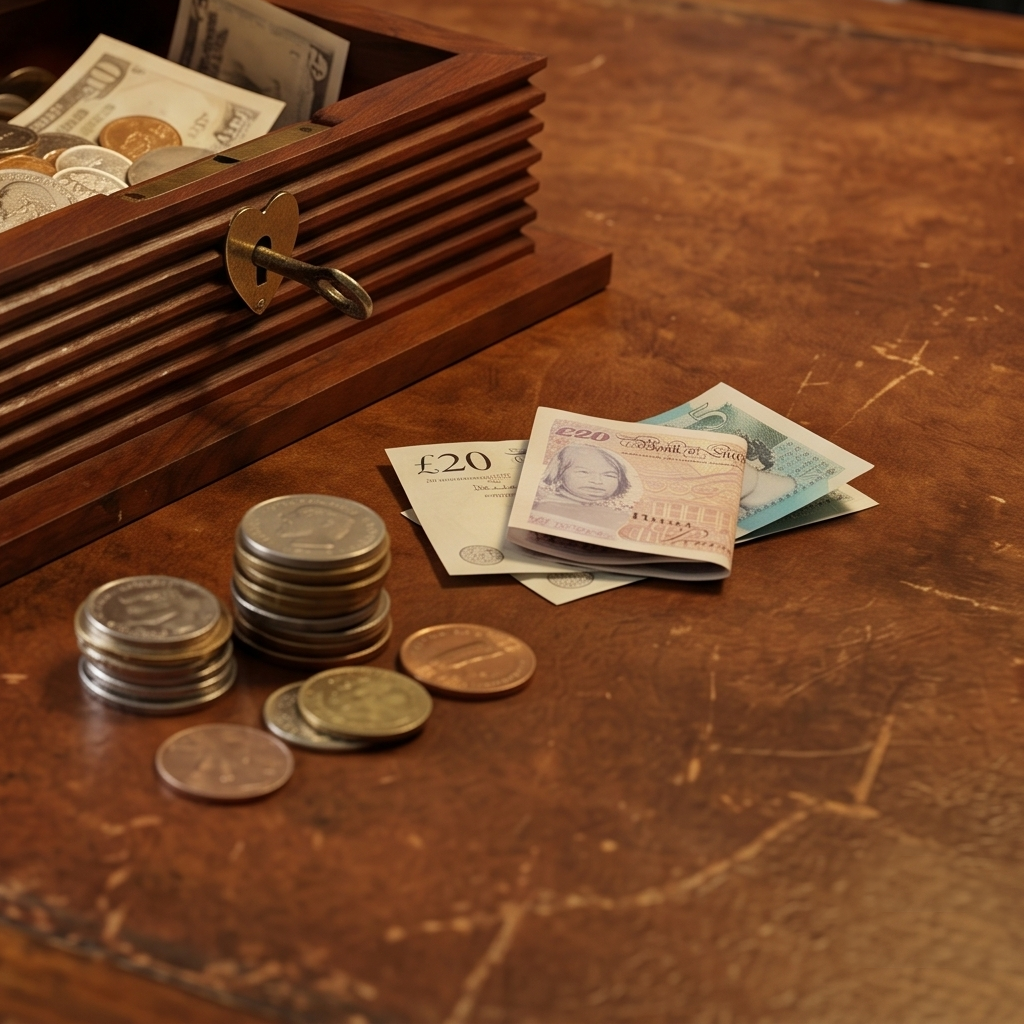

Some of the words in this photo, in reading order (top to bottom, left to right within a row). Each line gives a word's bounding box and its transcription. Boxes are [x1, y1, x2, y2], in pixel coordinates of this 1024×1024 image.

[689, 402, 728, 431] 5
[555, 427, 610, 442] £20
[414, 451, 492, 475] £20
